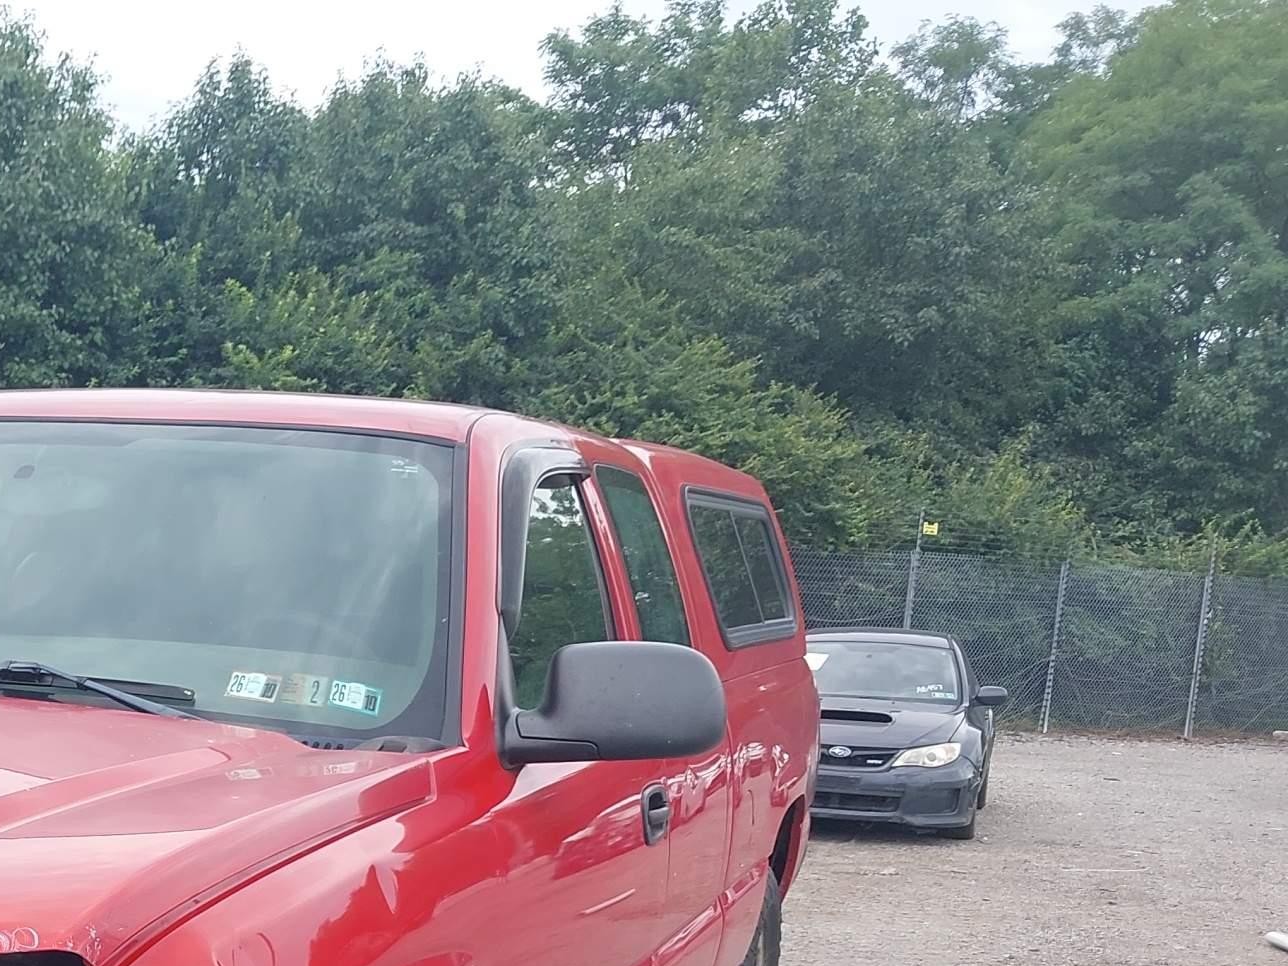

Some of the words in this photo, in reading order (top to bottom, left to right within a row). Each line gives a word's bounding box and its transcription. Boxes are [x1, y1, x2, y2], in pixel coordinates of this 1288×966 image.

[230, 674, 246, 693] 26
[310, 680, 321, 704] 2
[331, 683, 346, 703] 26
